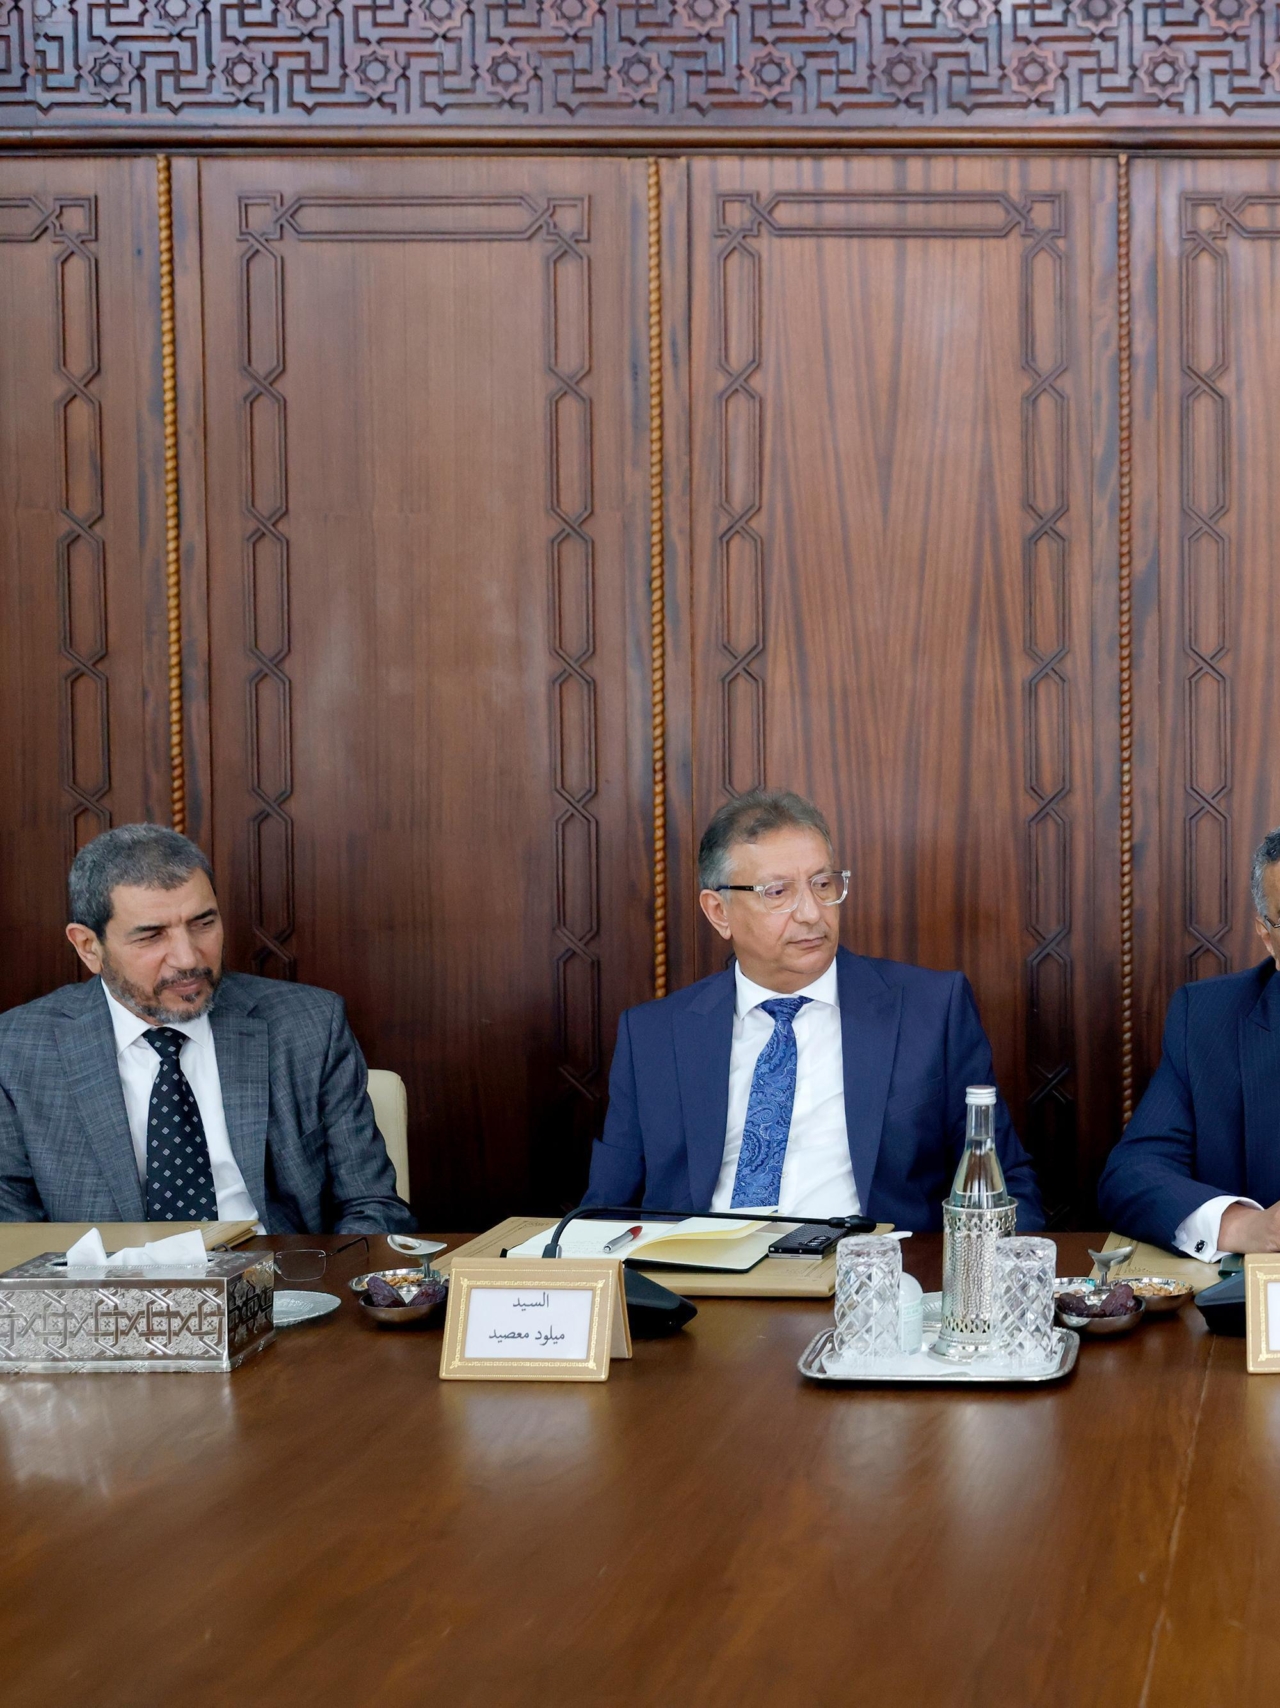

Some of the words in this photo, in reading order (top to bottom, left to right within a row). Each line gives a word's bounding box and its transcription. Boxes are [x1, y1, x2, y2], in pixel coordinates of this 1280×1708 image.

[513, 1291, 549, 1311] السيد
[488, 1328, 529, 1343] معصيد
[535, 1325, 565, 1346] ميلود
